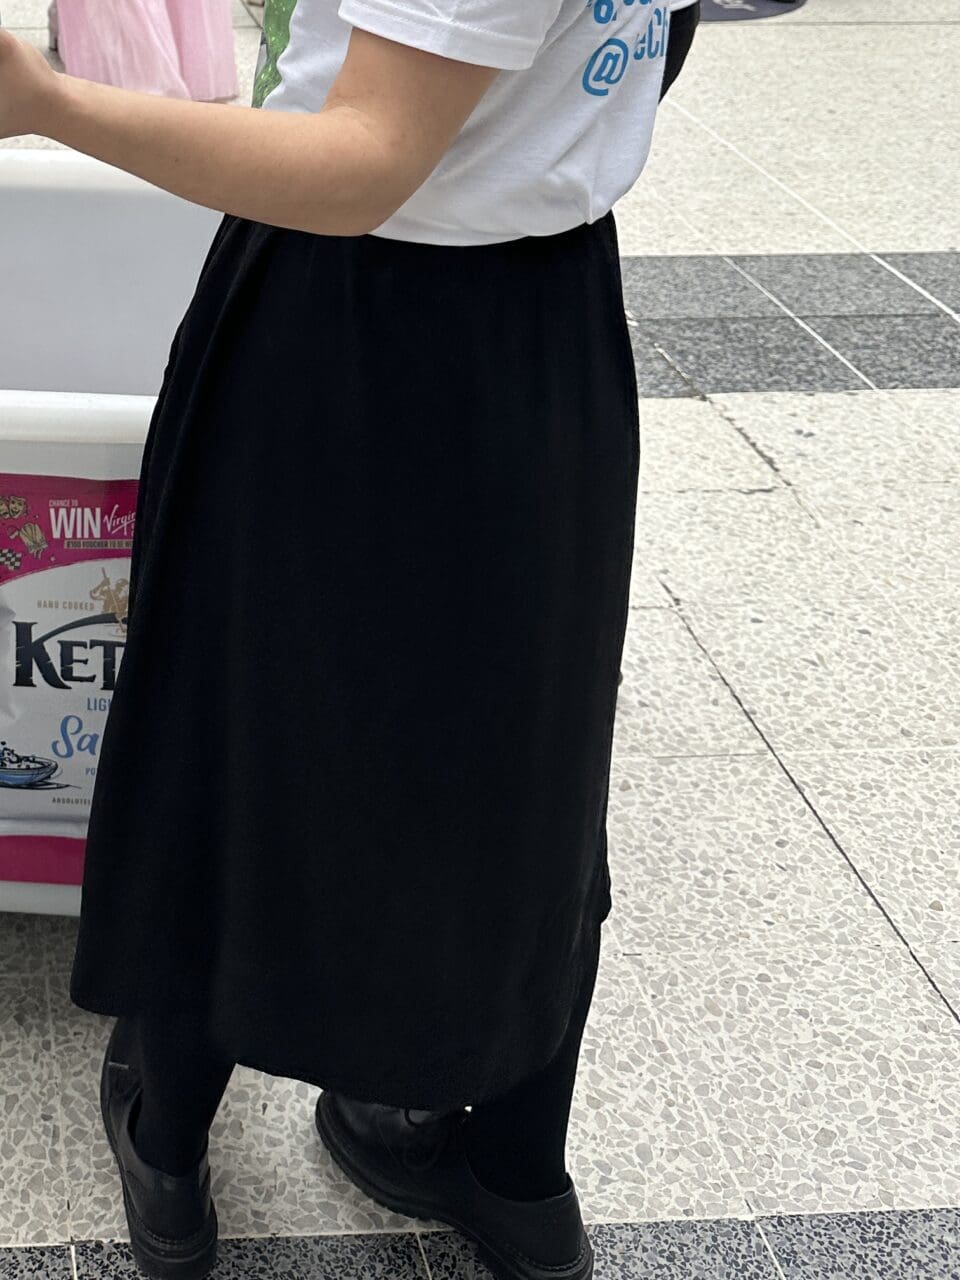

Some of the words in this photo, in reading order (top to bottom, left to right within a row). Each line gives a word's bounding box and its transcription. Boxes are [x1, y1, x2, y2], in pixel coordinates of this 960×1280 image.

[49, 499, 71, 507] CHANCE
[71, 499, 79, 507] TO
[49, 507, 101, 539] WIN
[37, 599, 60, 610] HAND
[63, 600, 95, 611] COOKED
[87, 697, 112, 712] LIG
